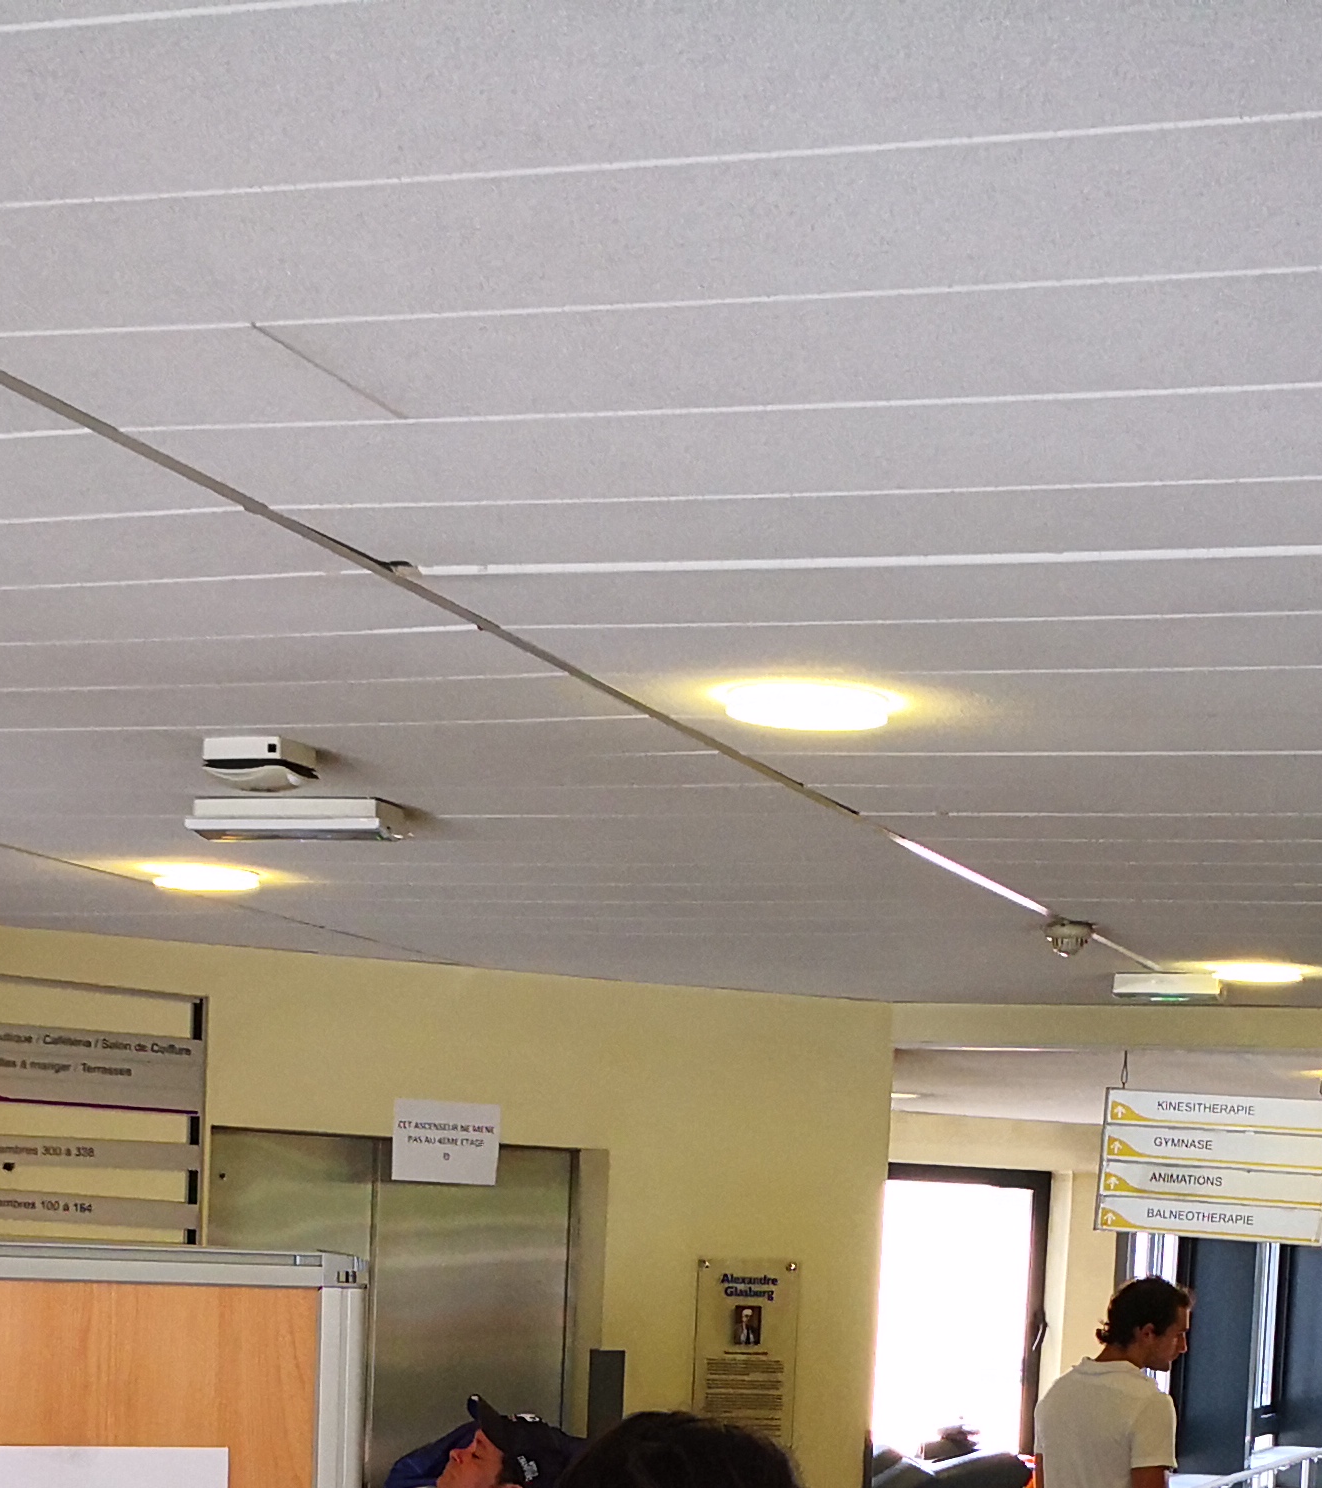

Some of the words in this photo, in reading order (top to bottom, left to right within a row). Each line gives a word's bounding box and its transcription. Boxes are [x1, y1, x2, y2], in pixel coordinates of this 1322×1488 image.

[102, 1039, 130, 1051] Salon
[135, 1043, 147, 1052] de
[151, 1043, 191, 1056] Coiffure
[30, 1061, 71, 1073] manger
[82, 1063, 132, 1076] Terrasses
[1157, 1101, 1255, 1115] KINESITHERAPIE
[1154, 1136, 1213, 1150] GYMNASE
[1150, 1172, 1222, 1186] ANIMATIONS
[41, 1200, 59, 1211] 100
[1147, 1208, 1254, 1225] BALNEOTHERAPIE
[721, 1273, 778, 1285] Alexandre
